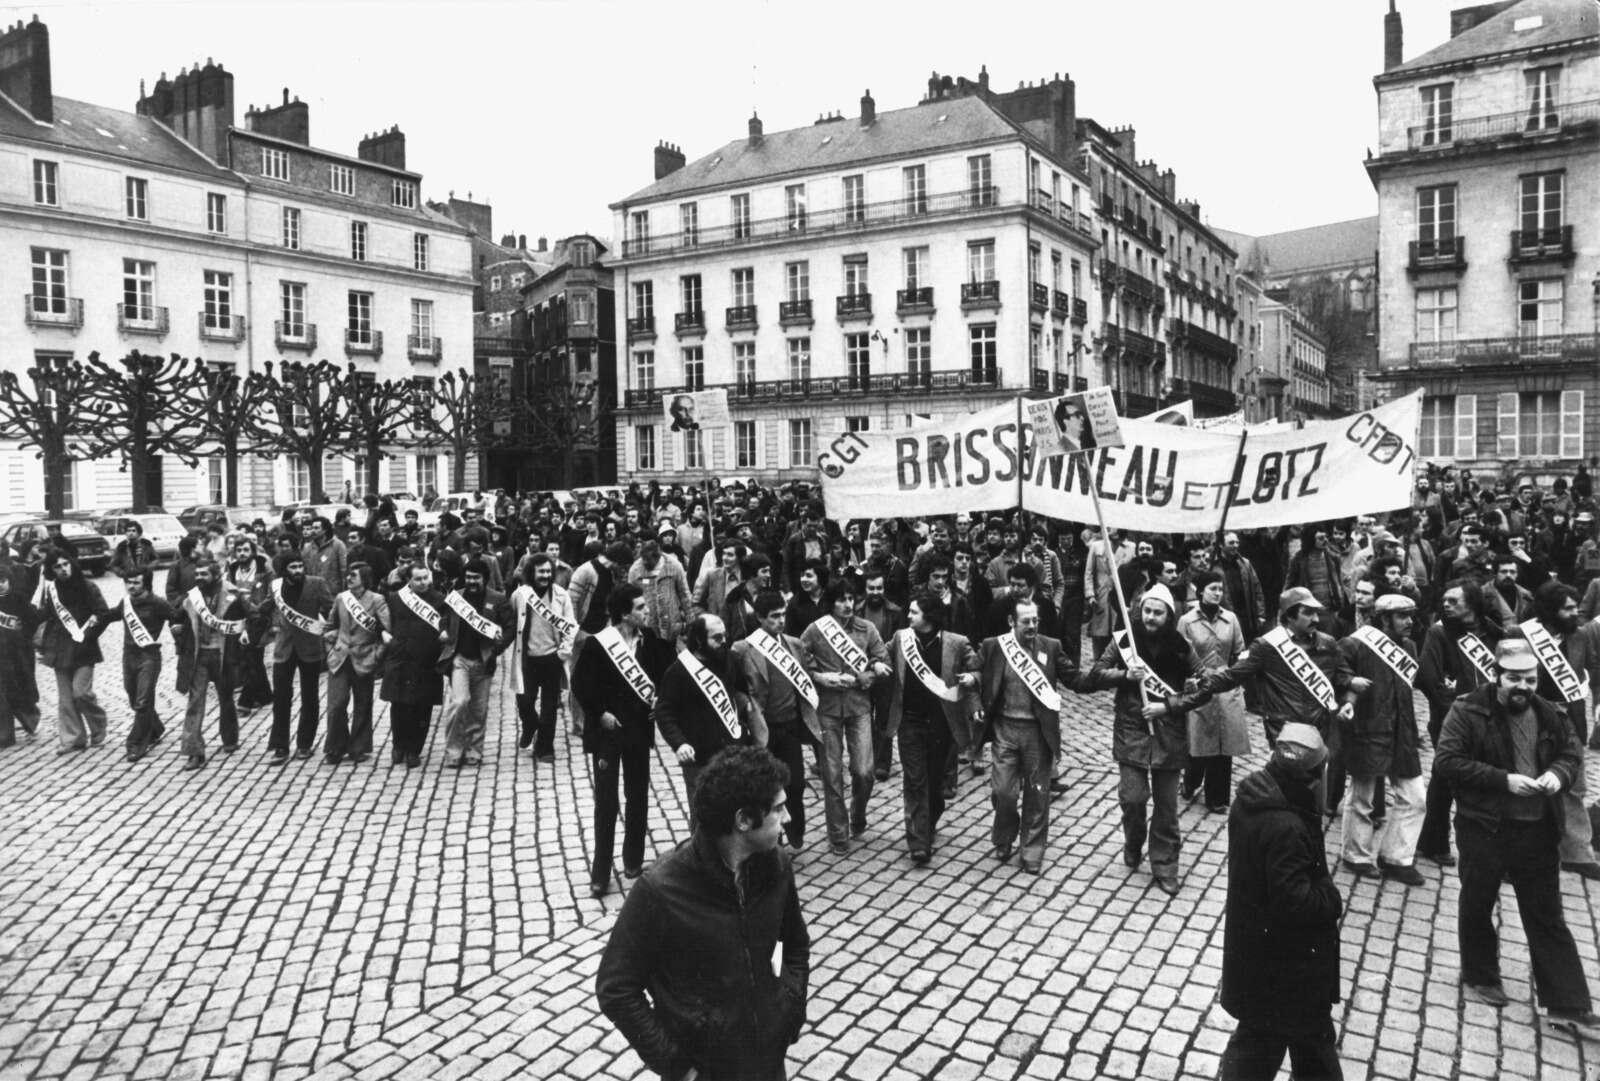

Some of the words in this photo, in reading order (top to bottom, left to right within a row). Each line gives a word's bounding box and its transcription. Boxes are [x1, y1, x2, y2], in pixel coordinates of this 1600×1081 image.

[818, 431, 870, 479] CGT
[1346, 412, 1416, 476] CFDT
[1181, 480, 1234, 510] ET
[1231, 442, 1328, 508] LOTZ
[528, 592, 577, 637] LICENCIE
[759, 635, 813, 698] LICENCIE
[1277, 638, 1335, 709] LICENCIE
[1365, 630, 1418, 680] LICENC
[1529, 628, 1583, 702] LICENCIE
